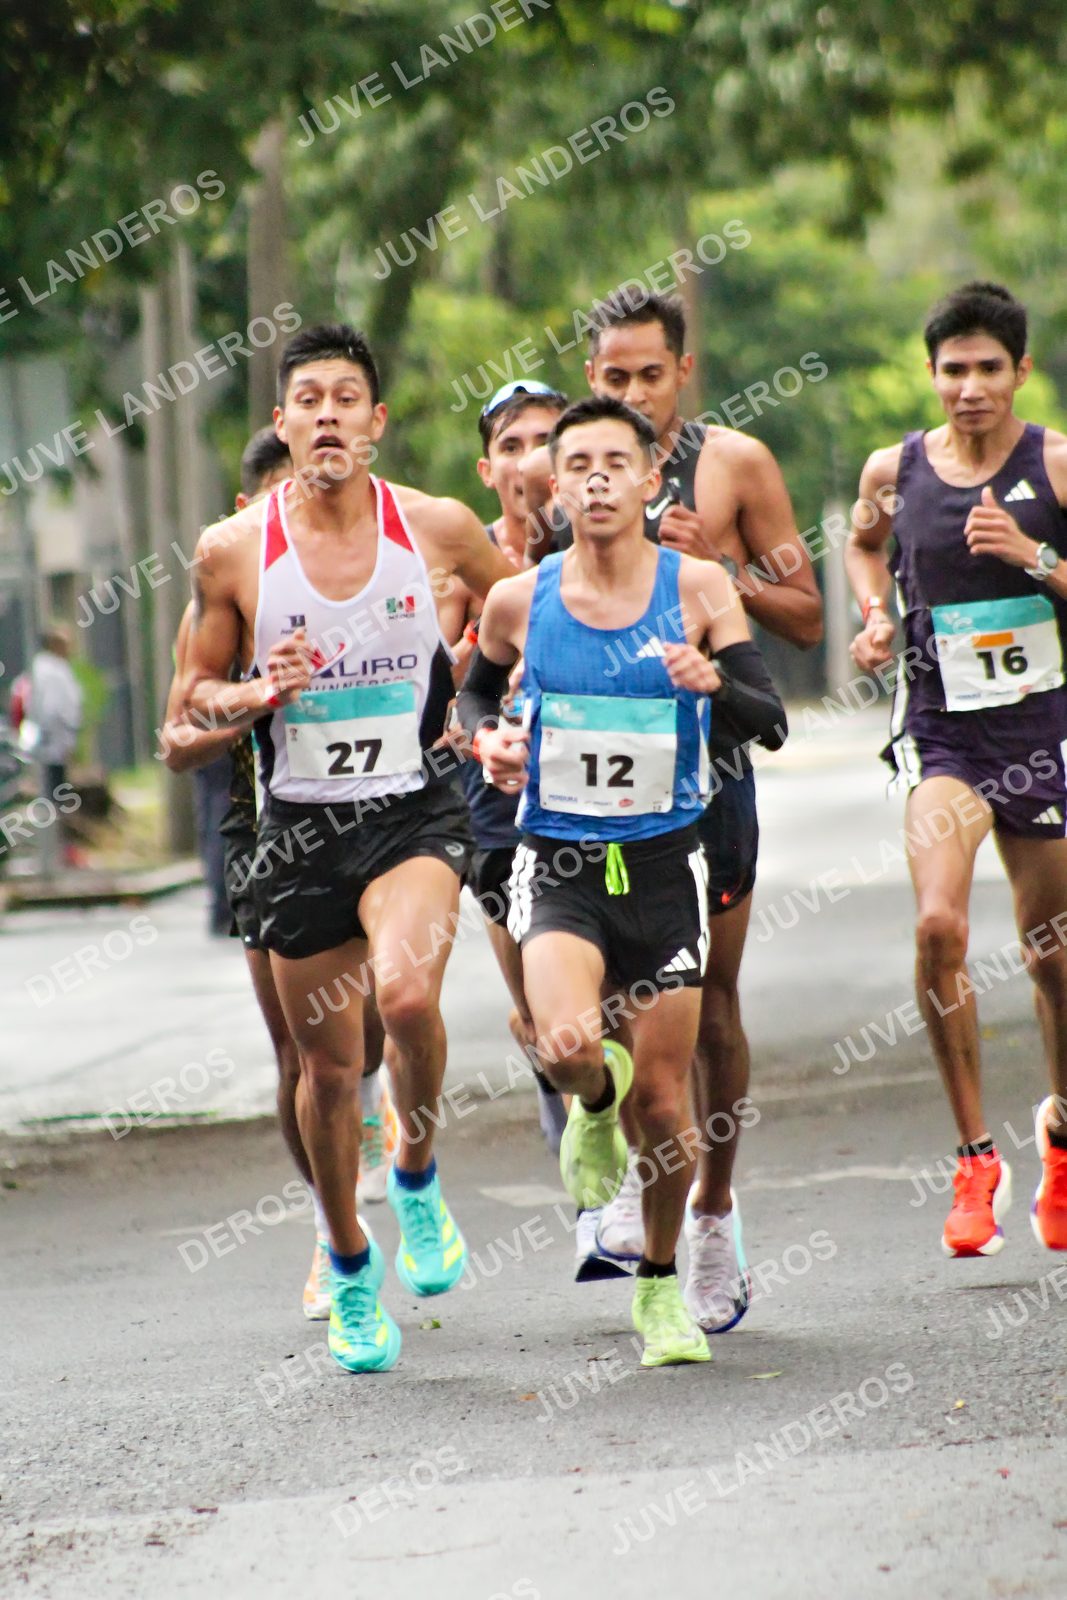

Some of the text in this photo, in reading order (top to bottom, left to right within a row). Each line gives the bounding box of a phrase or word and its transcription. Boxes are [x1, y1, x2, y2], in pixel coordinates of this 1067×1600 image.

[976, 646, 1028, 680] 16
[326, 739, 382, 776] 27
[580, 754, 634, 787] 12
